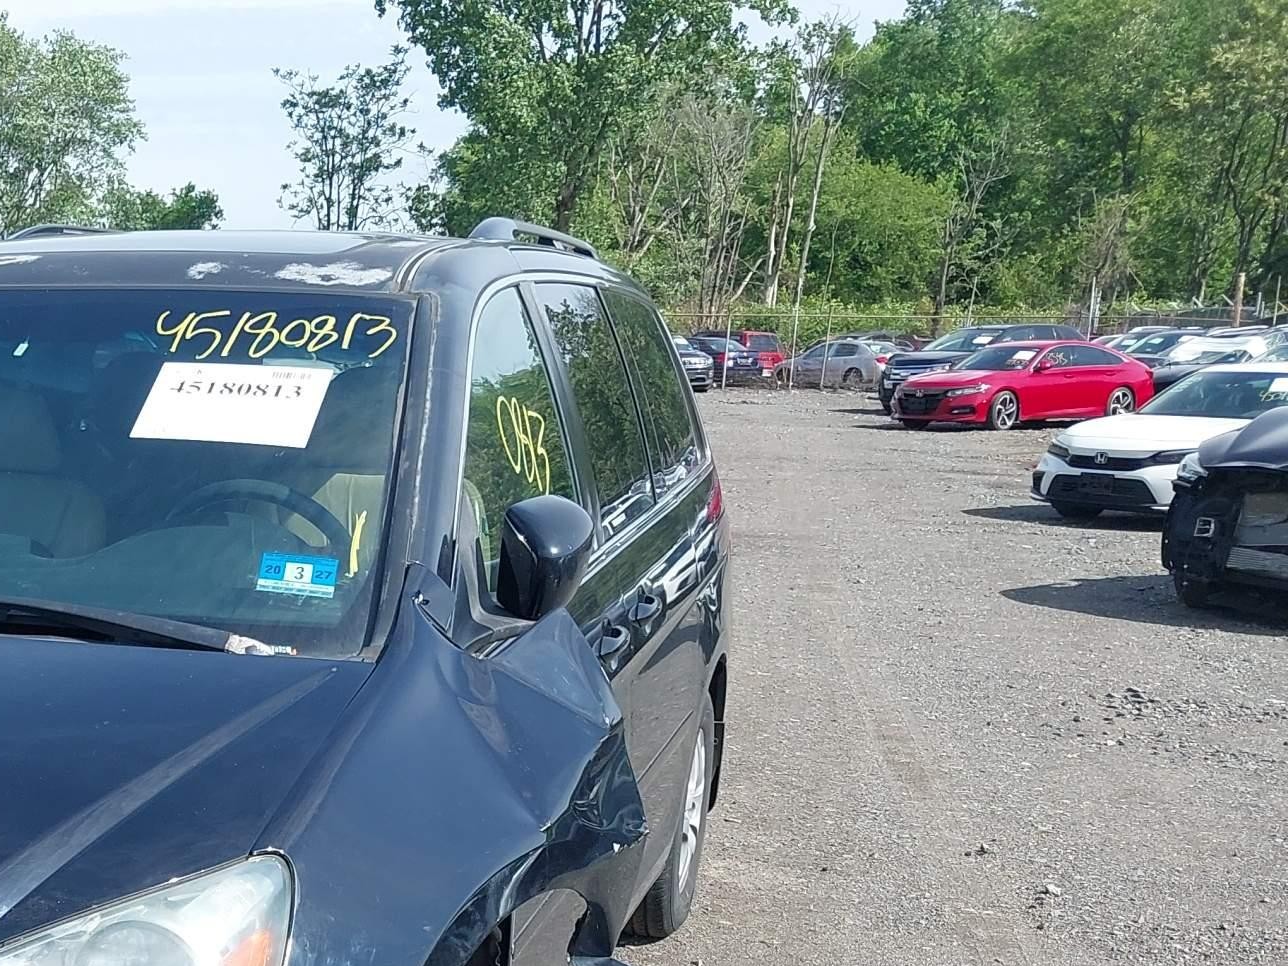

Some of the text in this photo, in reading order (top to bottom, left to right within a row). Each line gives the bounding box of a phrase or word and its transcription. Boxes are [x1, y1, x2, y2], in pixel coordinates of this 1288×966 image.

[156, 310, 397, 360] 45180813
[170, 380, 302, 399] 45180813
[264, 564, 333, 580] 20 3 27
